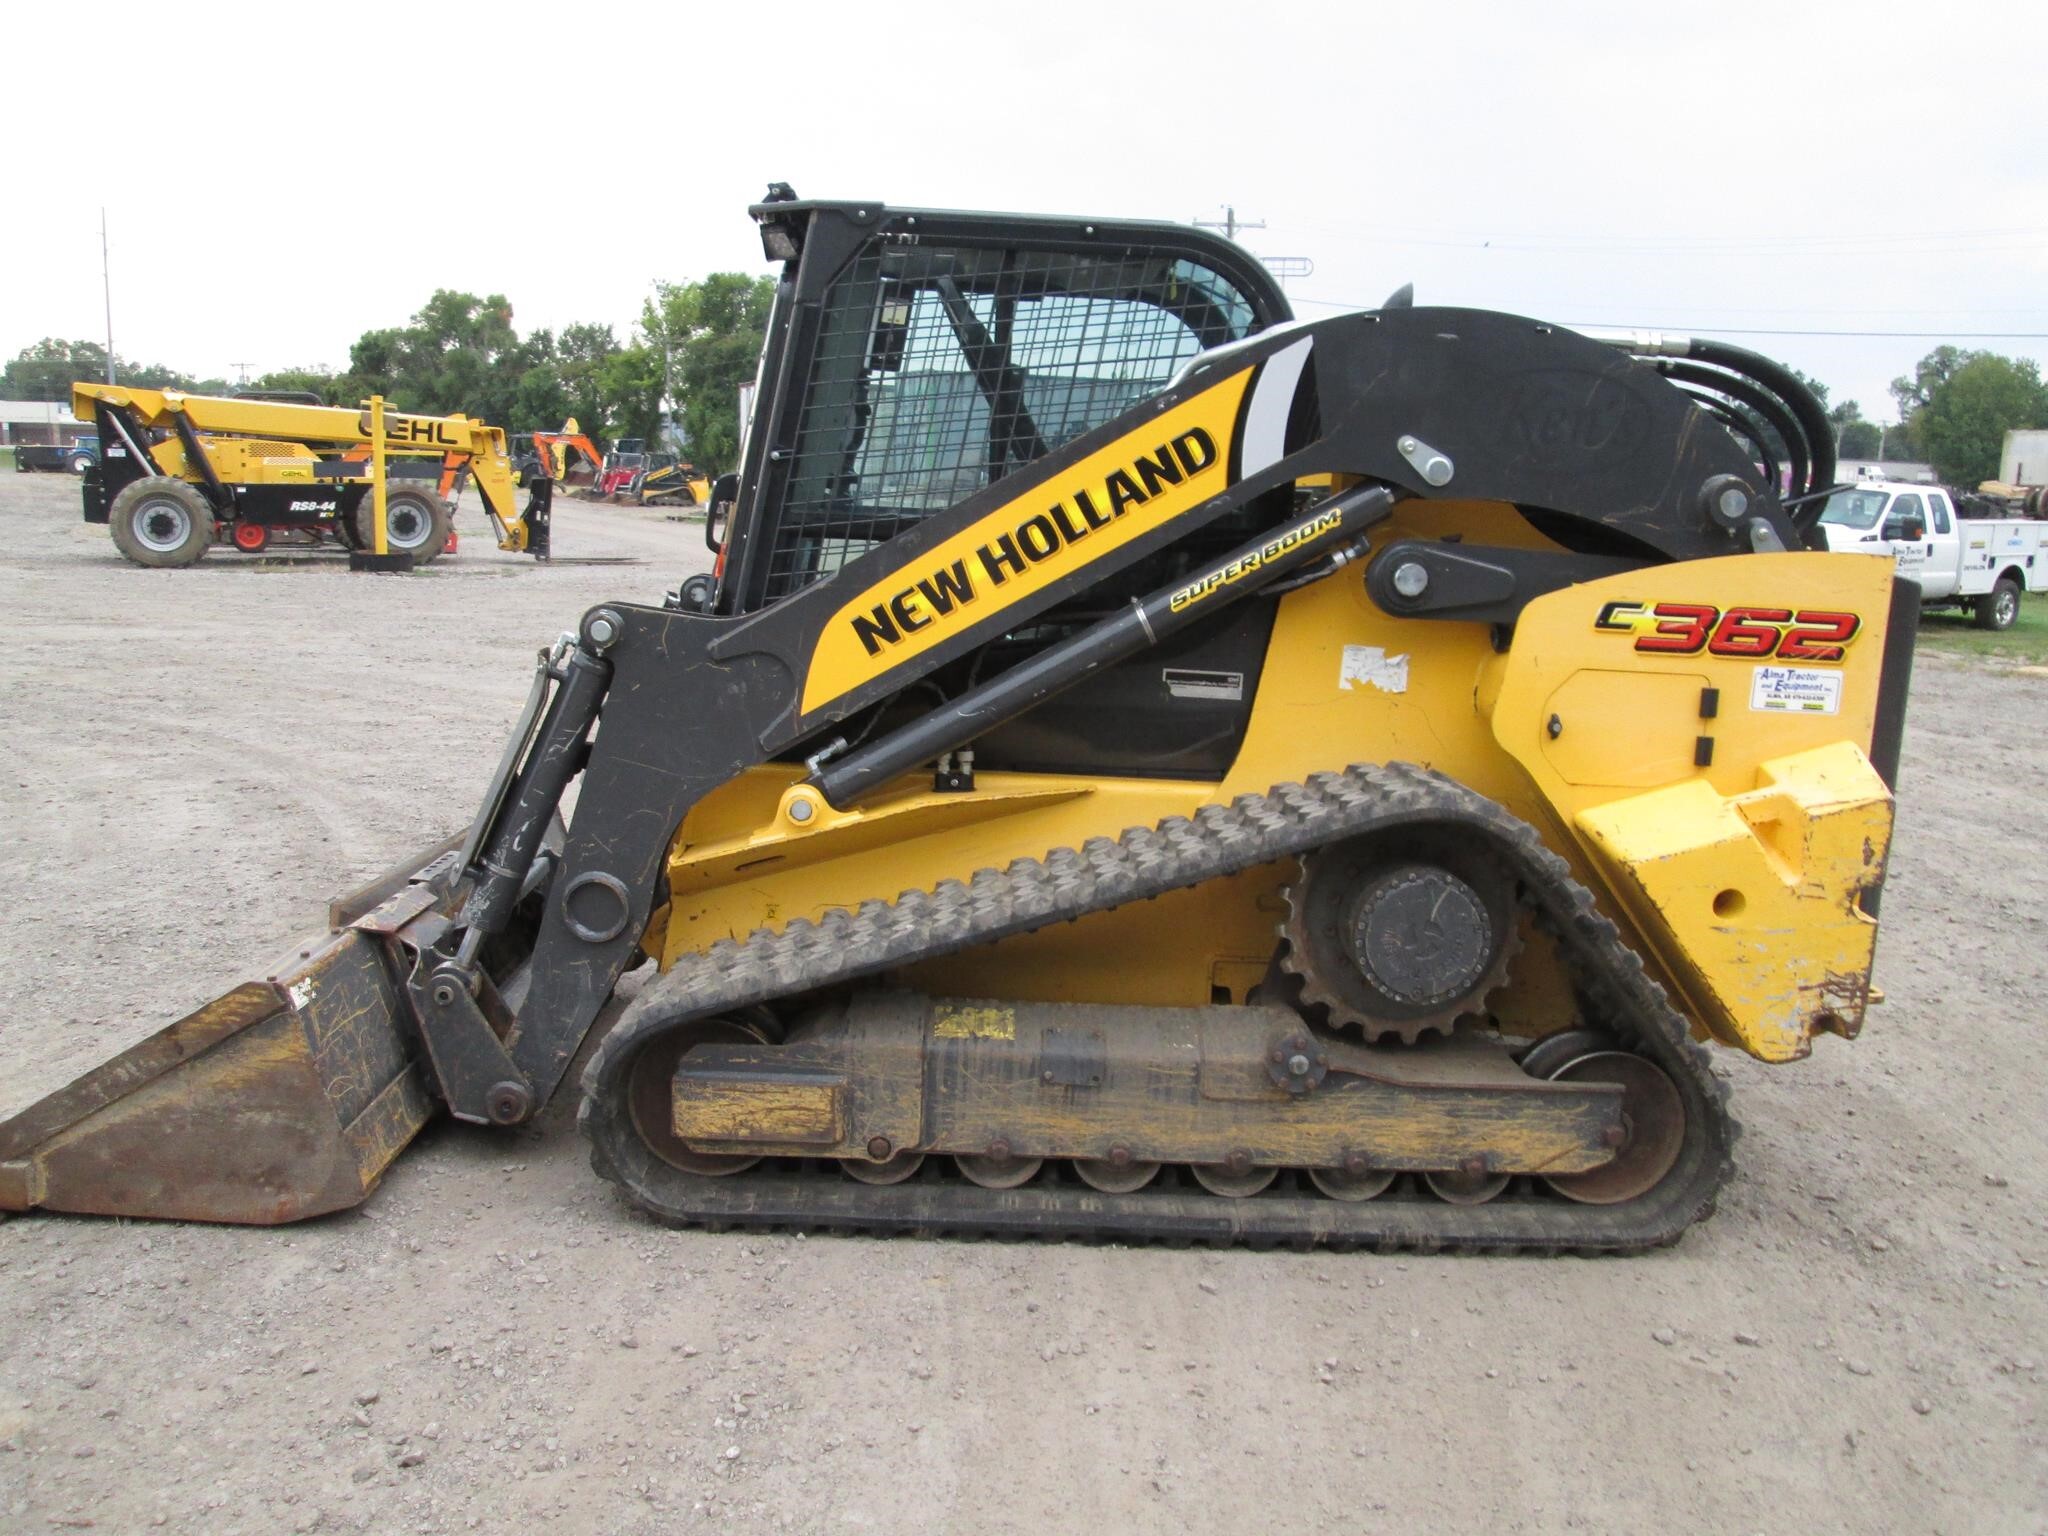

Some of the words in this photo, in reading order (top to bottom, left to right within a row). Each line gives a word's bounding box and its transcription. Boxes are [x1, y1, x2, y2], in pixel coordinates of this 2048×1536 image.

[290, 501, 336, 511] RS8-44
[850, 558, 976, 657] NEW
[975, 426, 1217, 586] HOLLAND
[1170, 551, 1261, 612] SUPER
[1262, 507, 1343, 564] BOOM
[1595, 600, 1862, 664] C362
[1760, 668, 1784, 680] Alma
[1787, 669, 1819, 681] Tractor
[1775, 680, 1823, 692] Equipment
